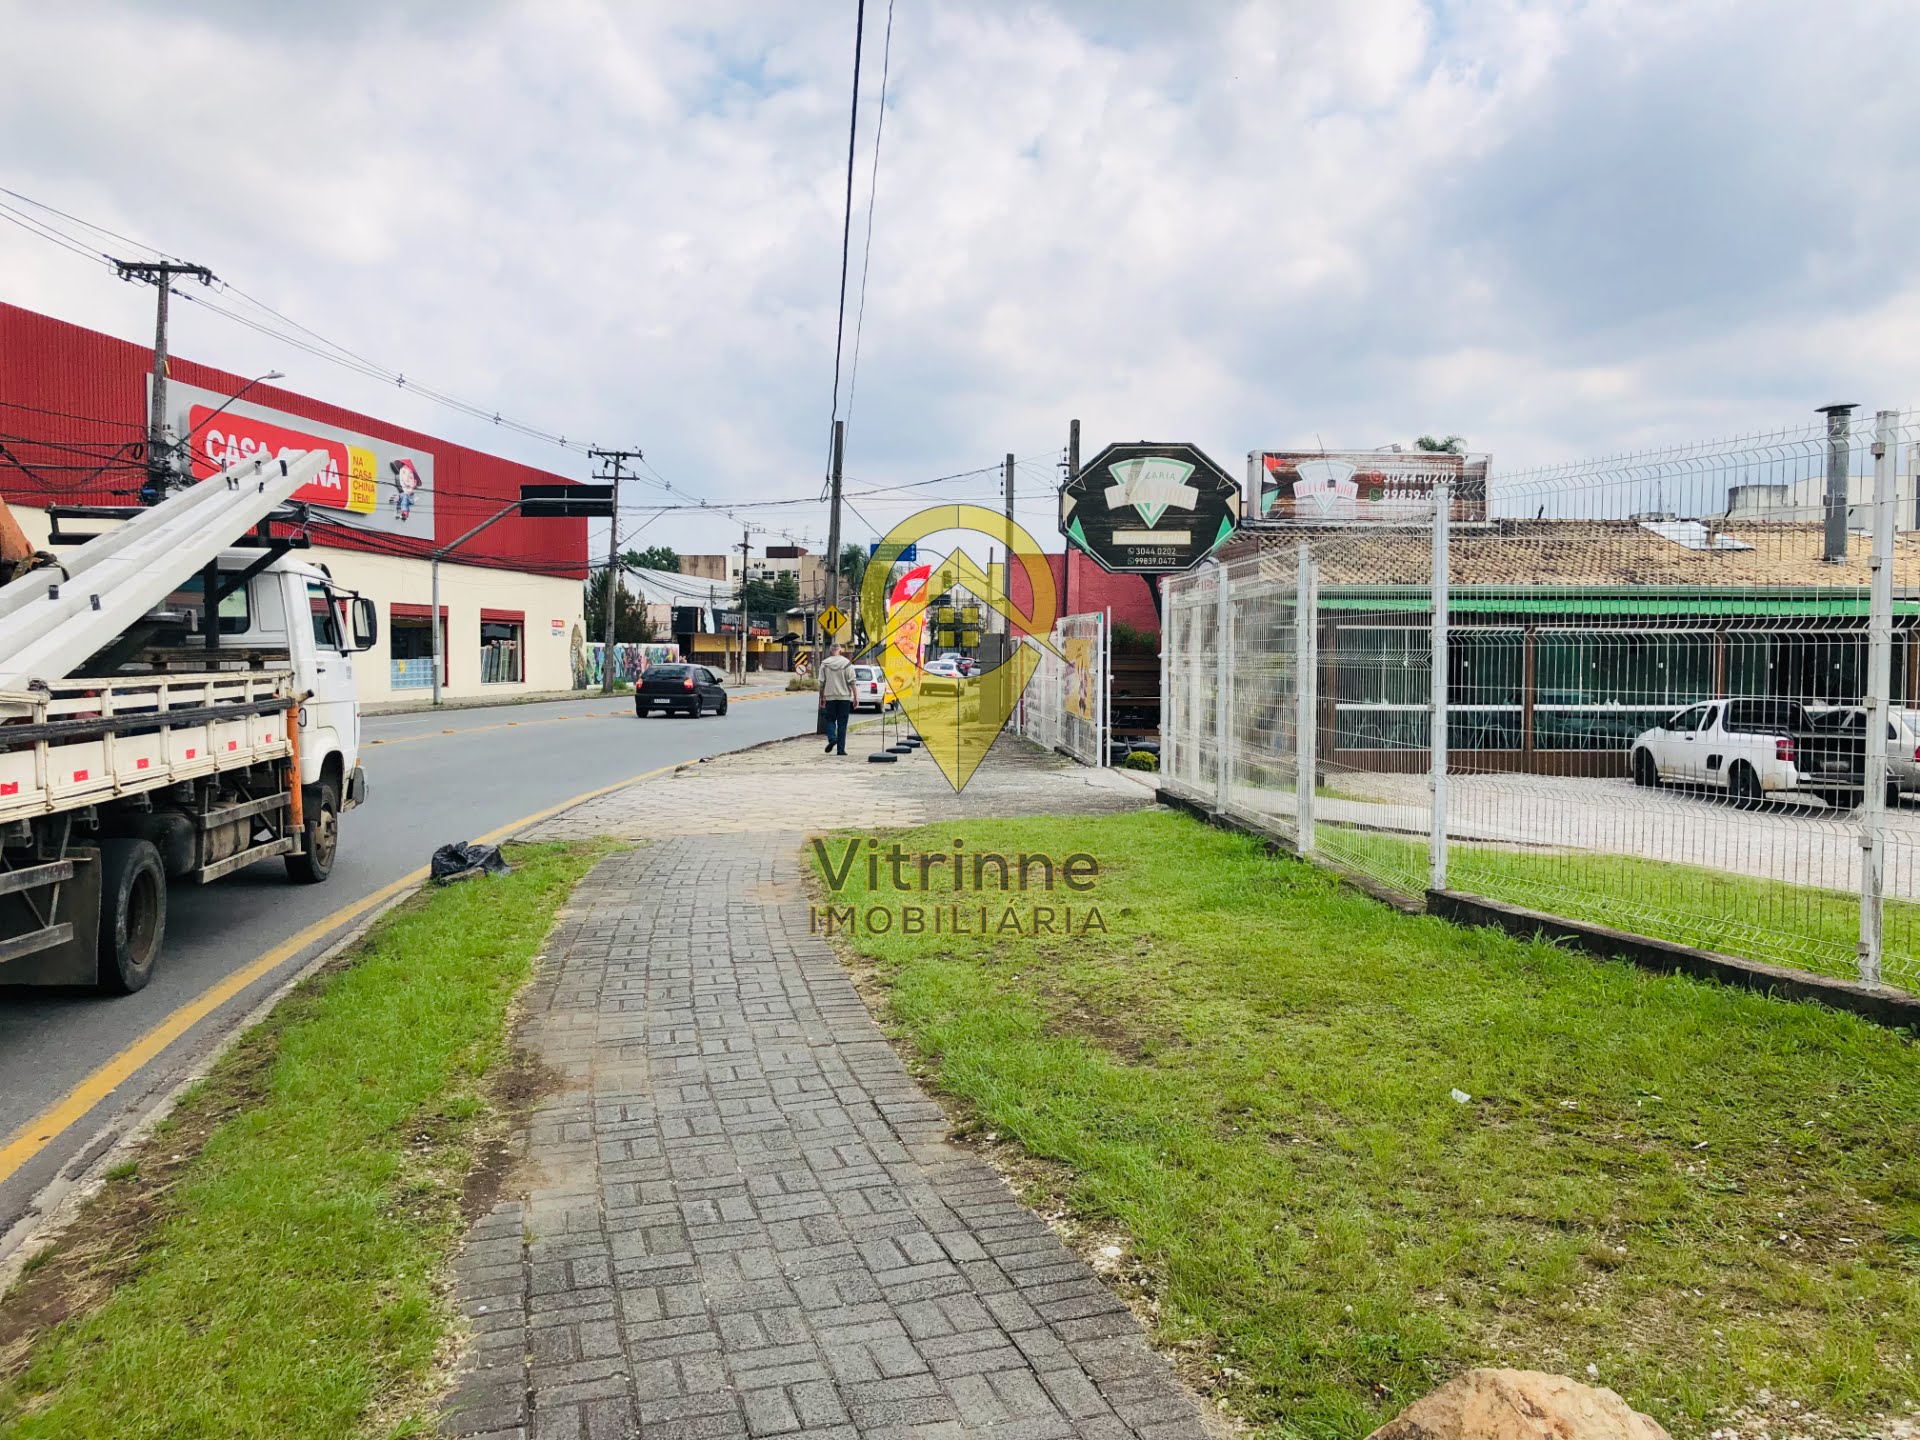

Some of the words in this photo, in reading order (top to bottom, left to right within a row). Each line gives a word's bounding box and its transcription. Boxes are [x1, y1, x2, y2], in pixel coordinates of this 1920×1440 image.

[353, 456, 363, 466] NA
[353, 468, 372, 480] CASA
[1383, 472, 1457, 483] 3044-0202
[353, 480, 375, 494] CHINA
[1382, 489, 1456, 500] 99839-02
